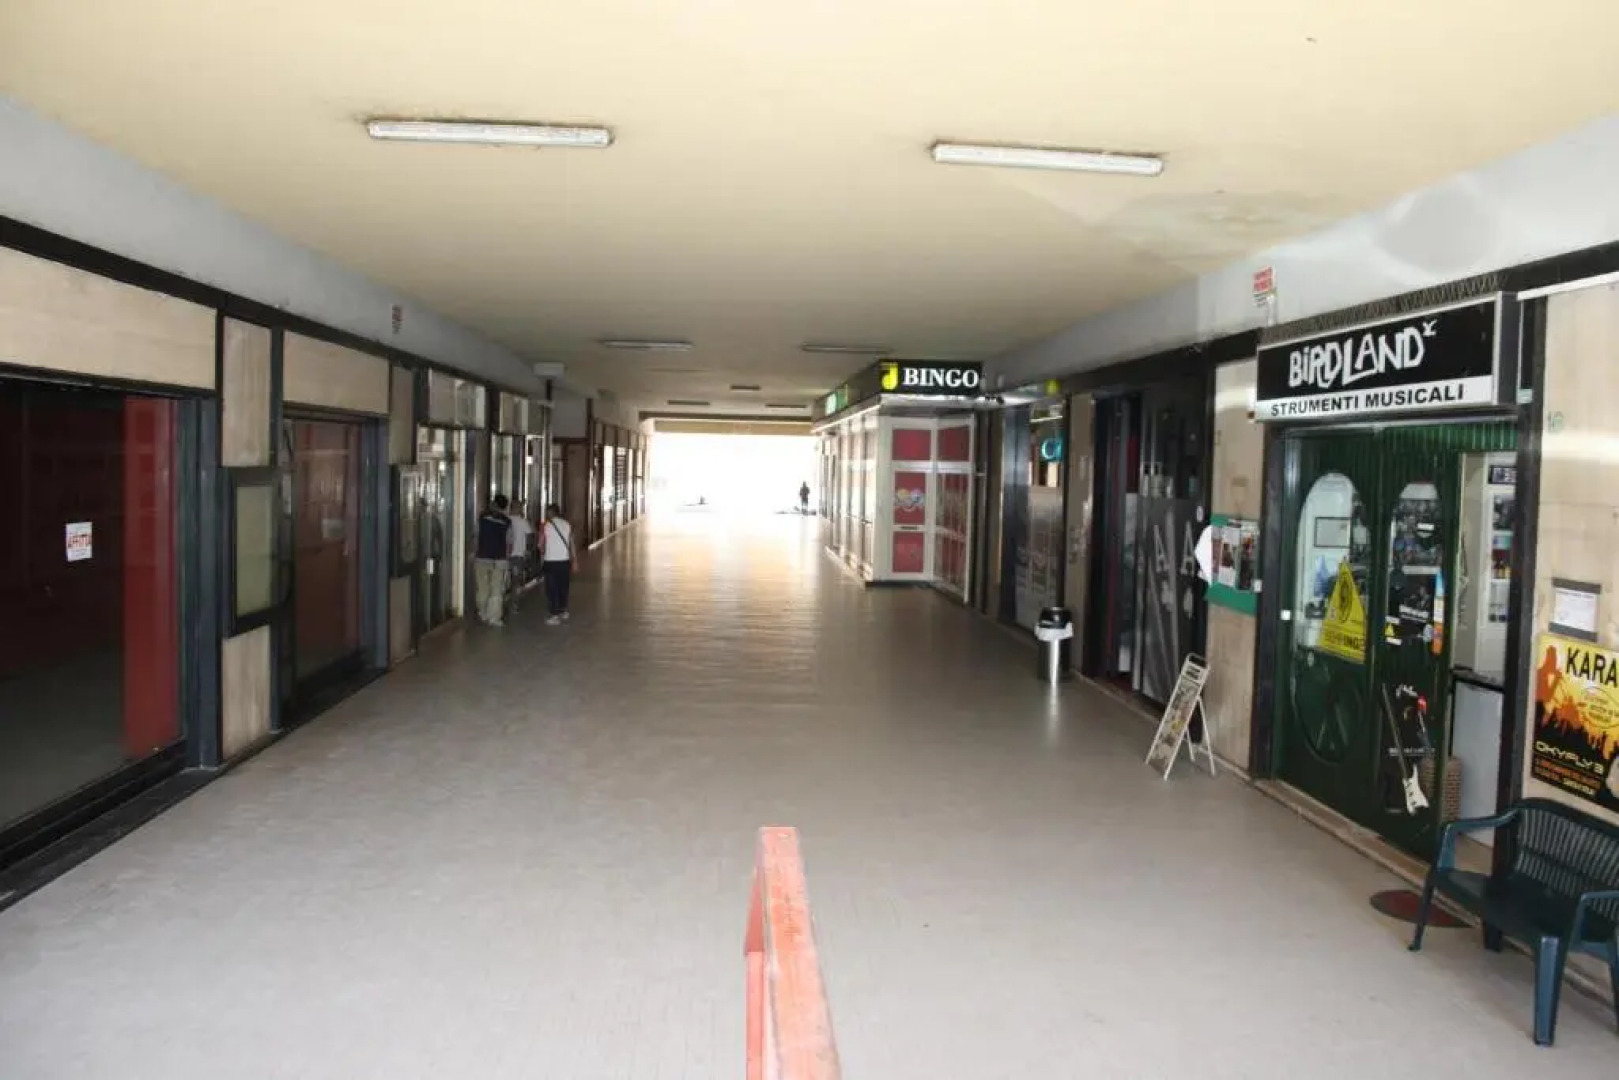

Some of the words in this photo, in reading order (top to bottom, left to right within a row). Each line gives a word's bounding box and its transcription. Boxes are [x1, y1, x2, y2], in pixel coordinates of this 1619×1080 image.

[903, 367, 979, 388] BINGO
[1271, 395, 1359, 416] STRUMENTI
[1365, 383, 1464, 408] MUSICALI
